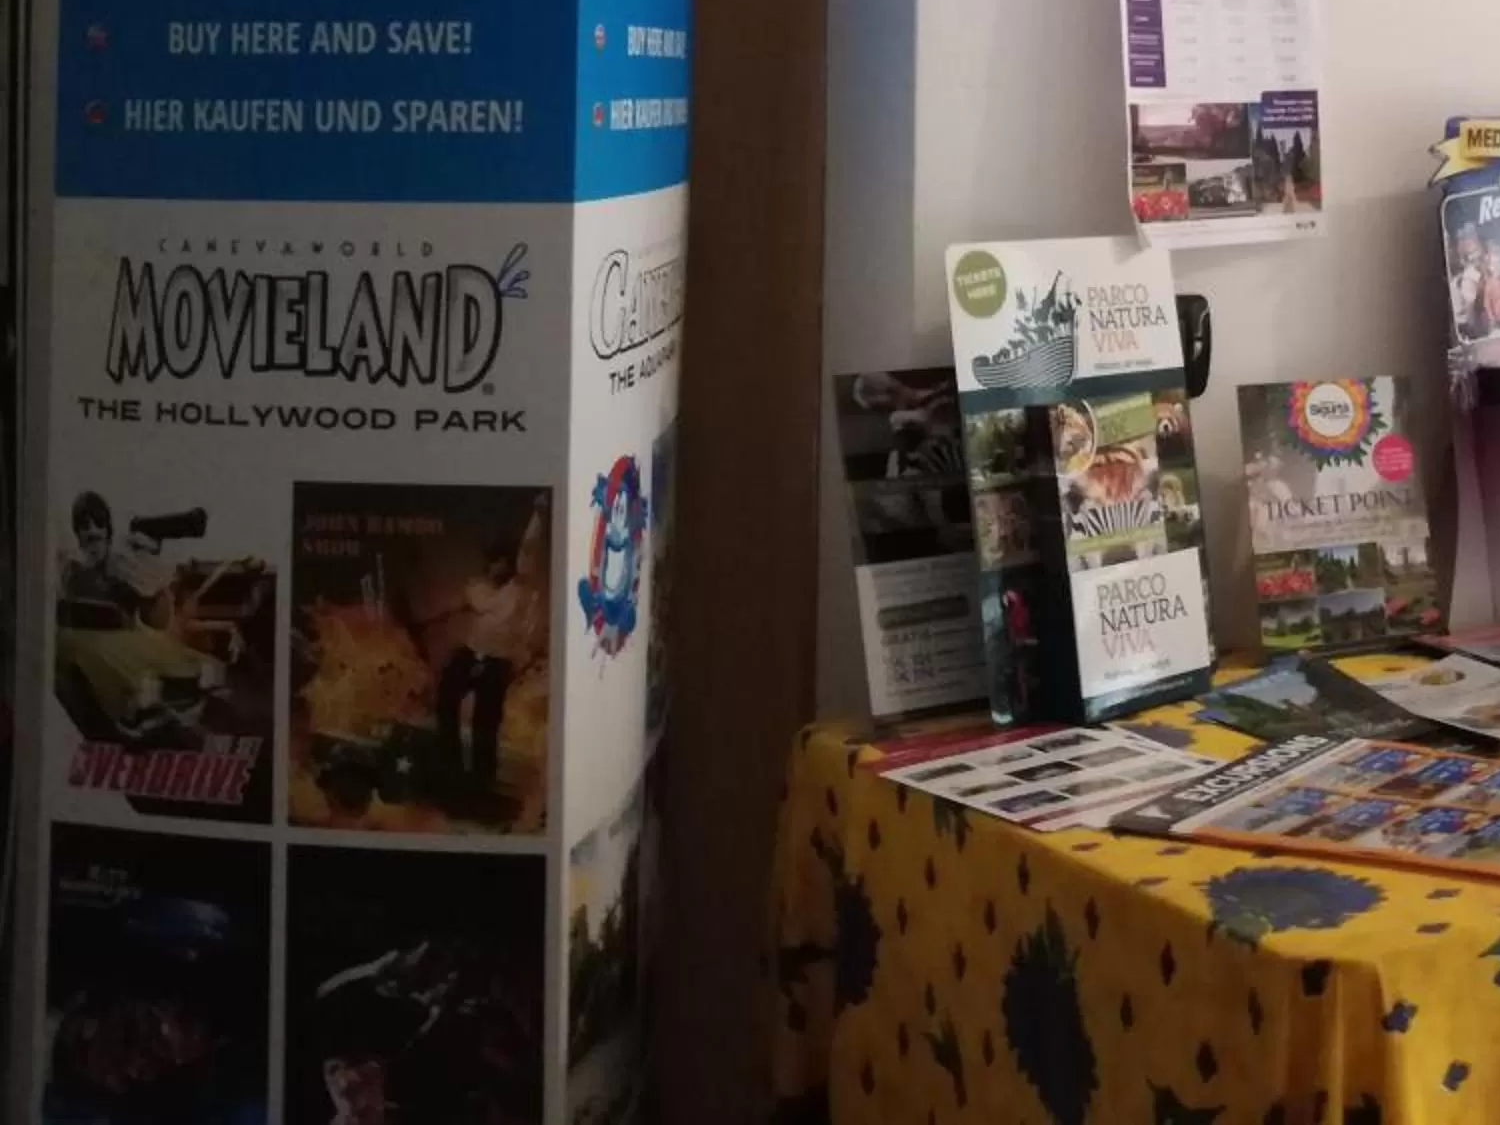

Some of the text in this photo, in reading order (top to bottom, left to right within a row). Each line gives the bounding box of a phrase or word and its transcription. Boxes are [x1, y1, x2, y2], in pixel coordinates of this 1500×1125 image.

[168, 22, 473, 54] BUY HERE AND SAVE!
[123, 100, 524, 133] HIER KAUFEN UND SPAREN!
[1087, 283, 1149, 306] PARCO
[107, 255, 504, 396] MOVIELAND
[1089, 304, 1168, 331] NATURA
[1093, 330, 1140, 353] VIVA
[78, 396, 528, 434] THE HOLLYWOOD PARK
[1266, 488, 1415, 521] TICKET POINT
[1097, 572, 1167, 605] PARCO
[1100, 595, 1189, 636] NATURA
[1101, 630, 1157, 660] VIVA
[68, 741, 251, 805] OVERDRIVE
[1172, 734, 1330, 802] EXCURSIONS
